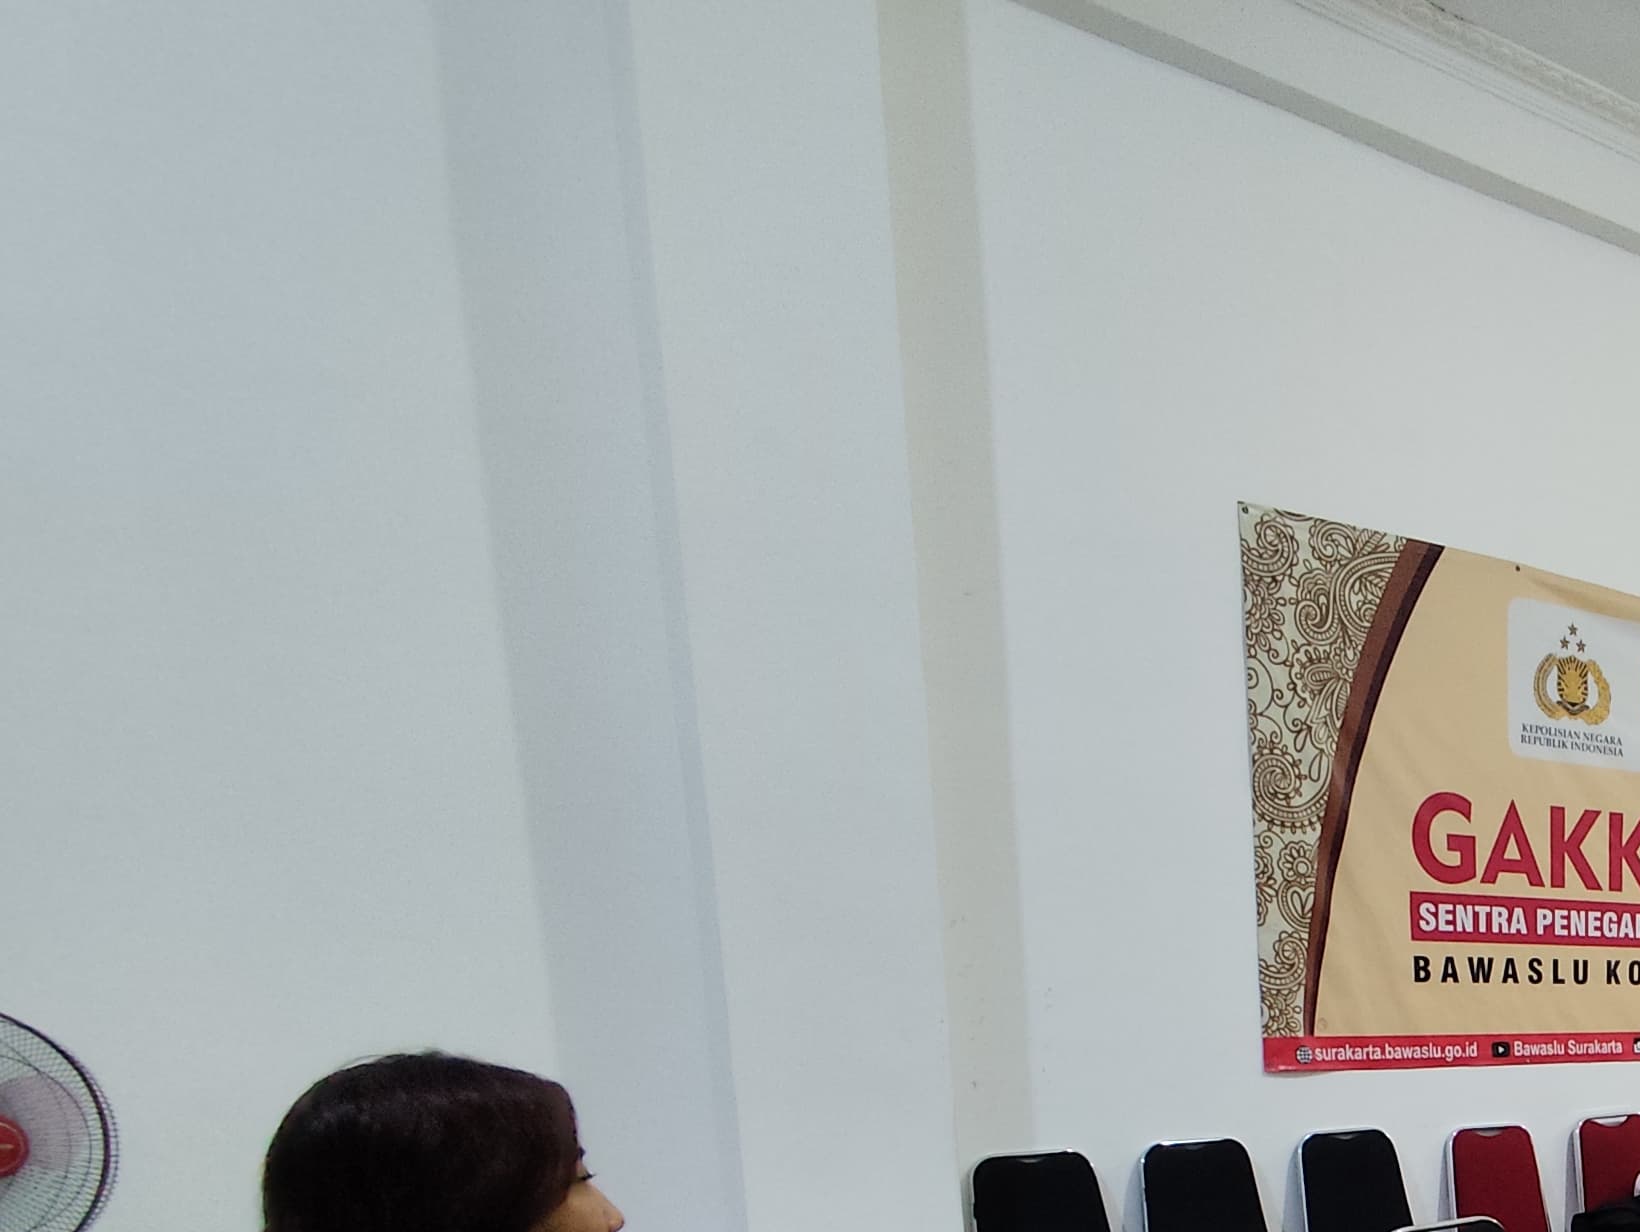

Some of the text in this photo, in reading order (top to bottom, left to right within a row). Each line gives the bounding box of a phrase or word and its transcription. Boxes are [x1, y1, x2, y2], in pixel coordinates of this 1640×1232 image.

[1520, 734, 1624, 757] REPUBLIK INDONESIA
[1521, 723, 1623, 746] KEPOLISIAN NEGARA
[1418, 902, 1528, 935] SENTRA
[1413, 955, 1589, 985] BAWASLU
[1315, 1043, 1478, 1062] surakarta.bawaslu.go.id
[1514, 1039, 1623, 1057] Bawaslu Surakarta
